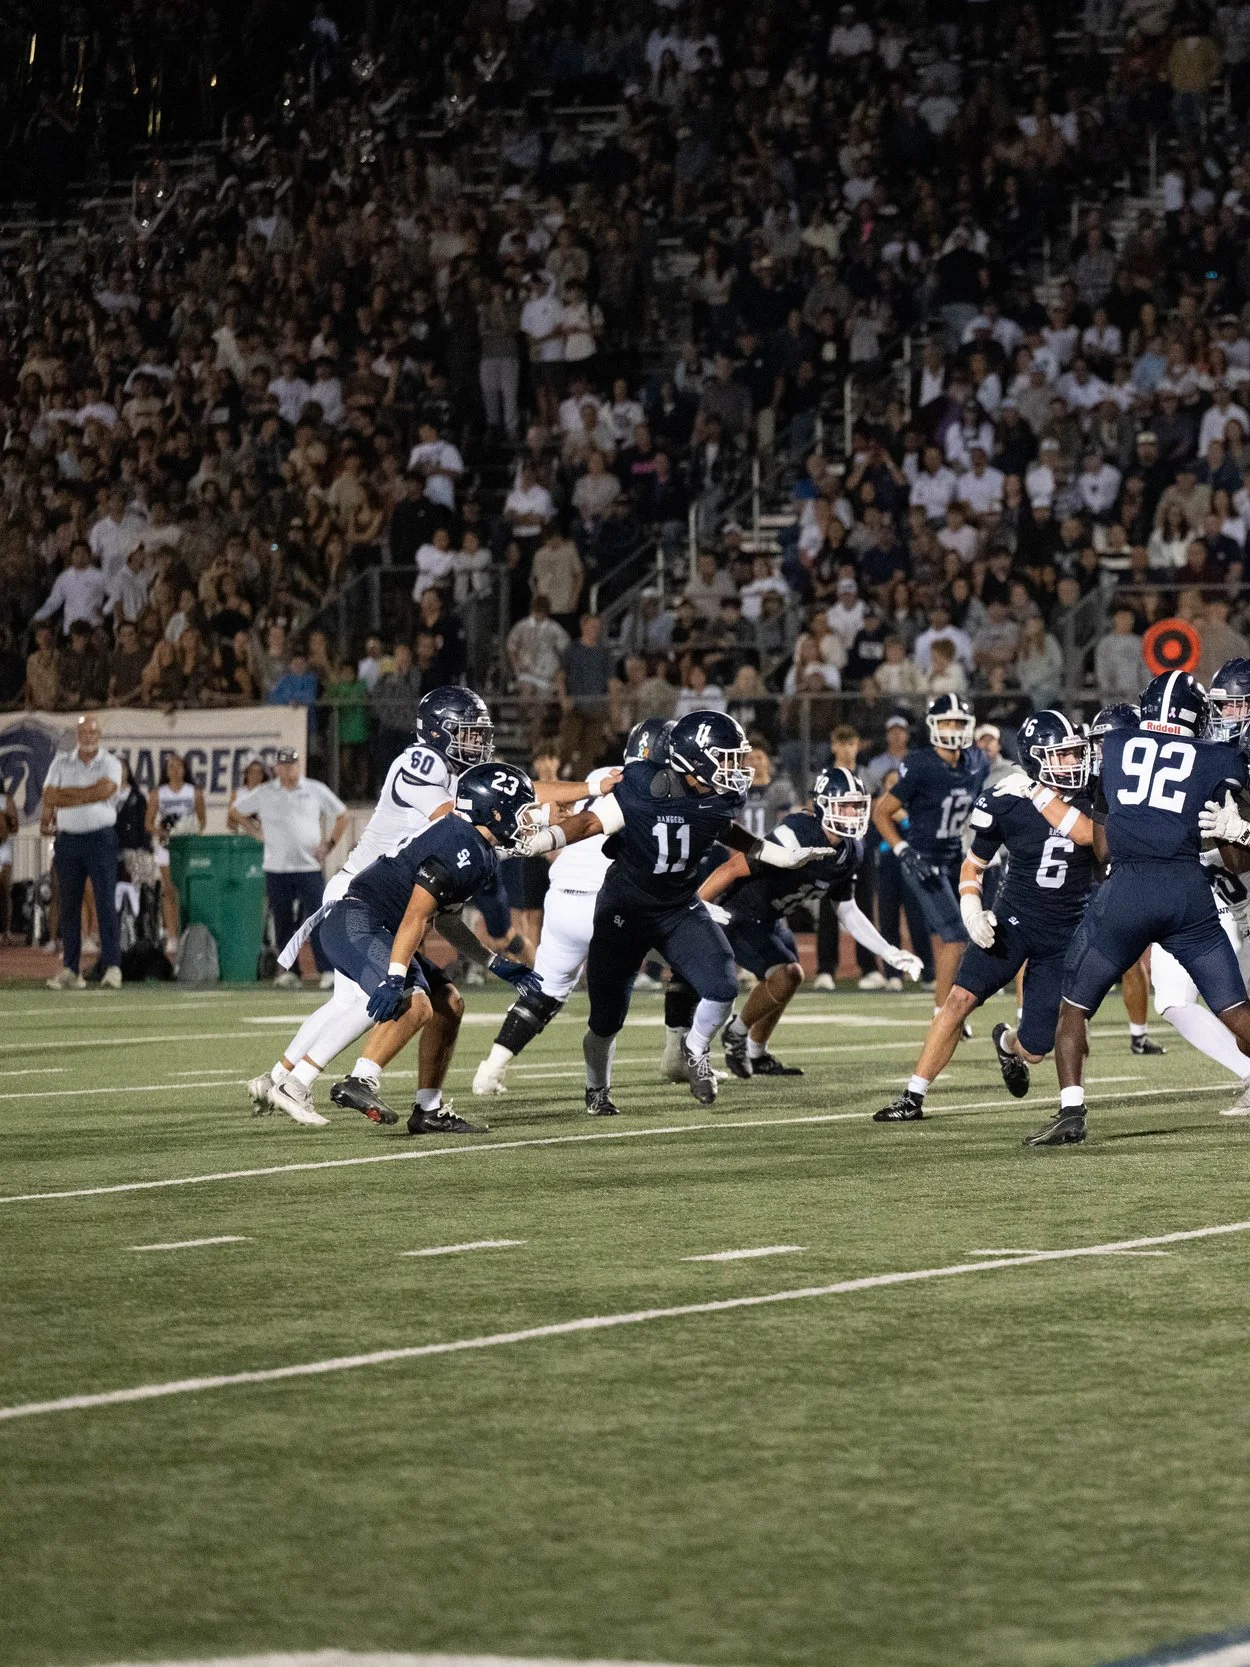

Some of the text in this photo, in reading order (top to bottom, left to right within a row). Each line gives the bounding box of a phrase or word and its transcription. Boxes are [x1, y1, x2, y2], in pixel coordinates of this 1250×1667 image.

[1147, 722, 1181, 735] Riddell
[410, 751, 435, 776] 60
[1117, 737, 1197, 813] 92
[491, 771, 519, 796] 23
[936, 795, 972, 839] 12
[652, 822, 691, 874] 11
[1036, 836, 1074, 889] 6
[613, 914, 625, 927] SV
